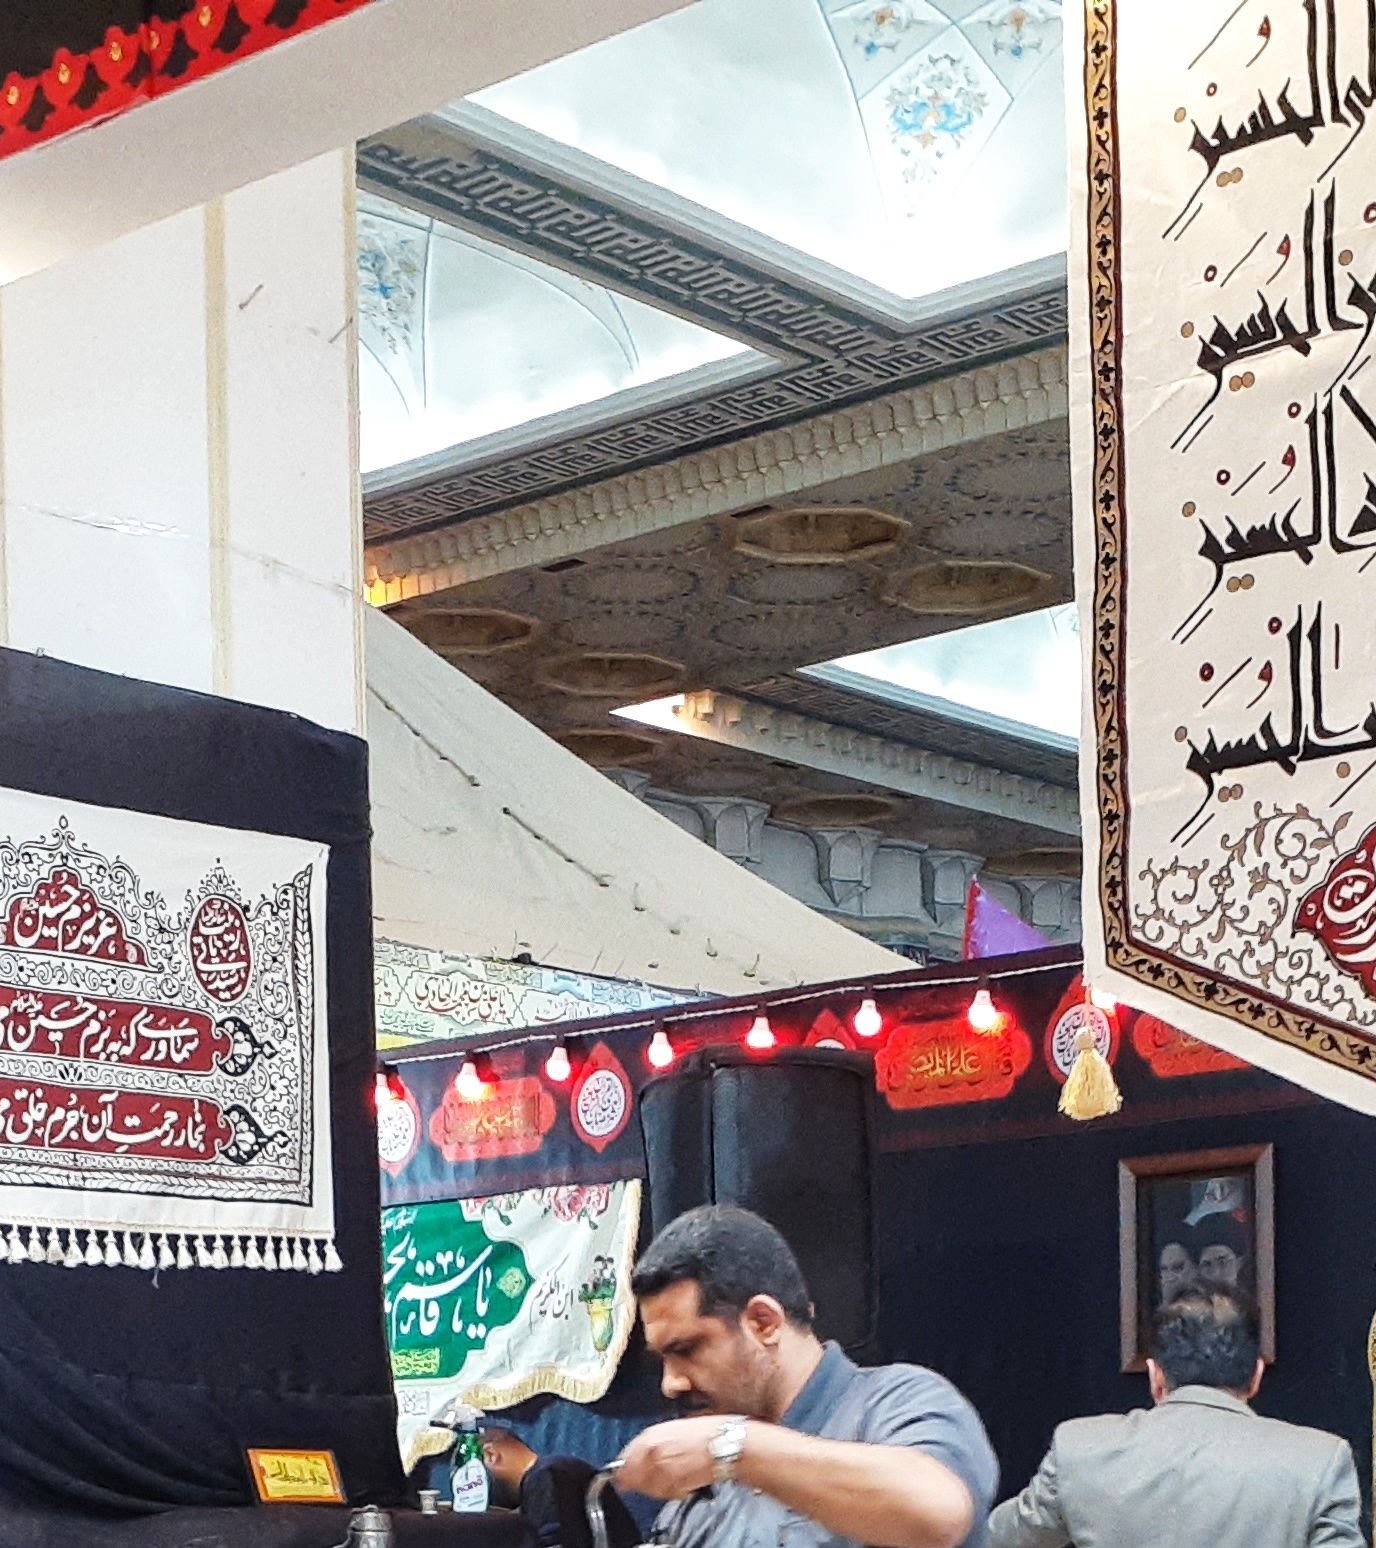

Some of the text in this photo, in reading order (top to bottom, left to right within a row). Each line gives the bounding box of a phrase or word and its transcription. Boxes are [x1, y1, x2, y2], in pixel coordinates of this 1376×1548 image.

[1163, 0, 1358, 239] الحسین
[1171, 178, 1364, 449] الحسین
[1172, 380, 1376, 642] الحسین
[1170, 604, 1364, 846] الحسین
[14, 884, 117, 955] عزیزم حسین
[7, 997, 98, 1053] حسین
[80, 1008, 112, 1062] بزم
[106, 1036, 124, 1062] به
[121, 1007, 147, 1056] که
[138, 1010, 199, 1063] سماوری
[6, 1088, 48, 1142] خلق
[45, 1098, 81, 1148] جرم
[82, 1091, 119, 1142] آن
